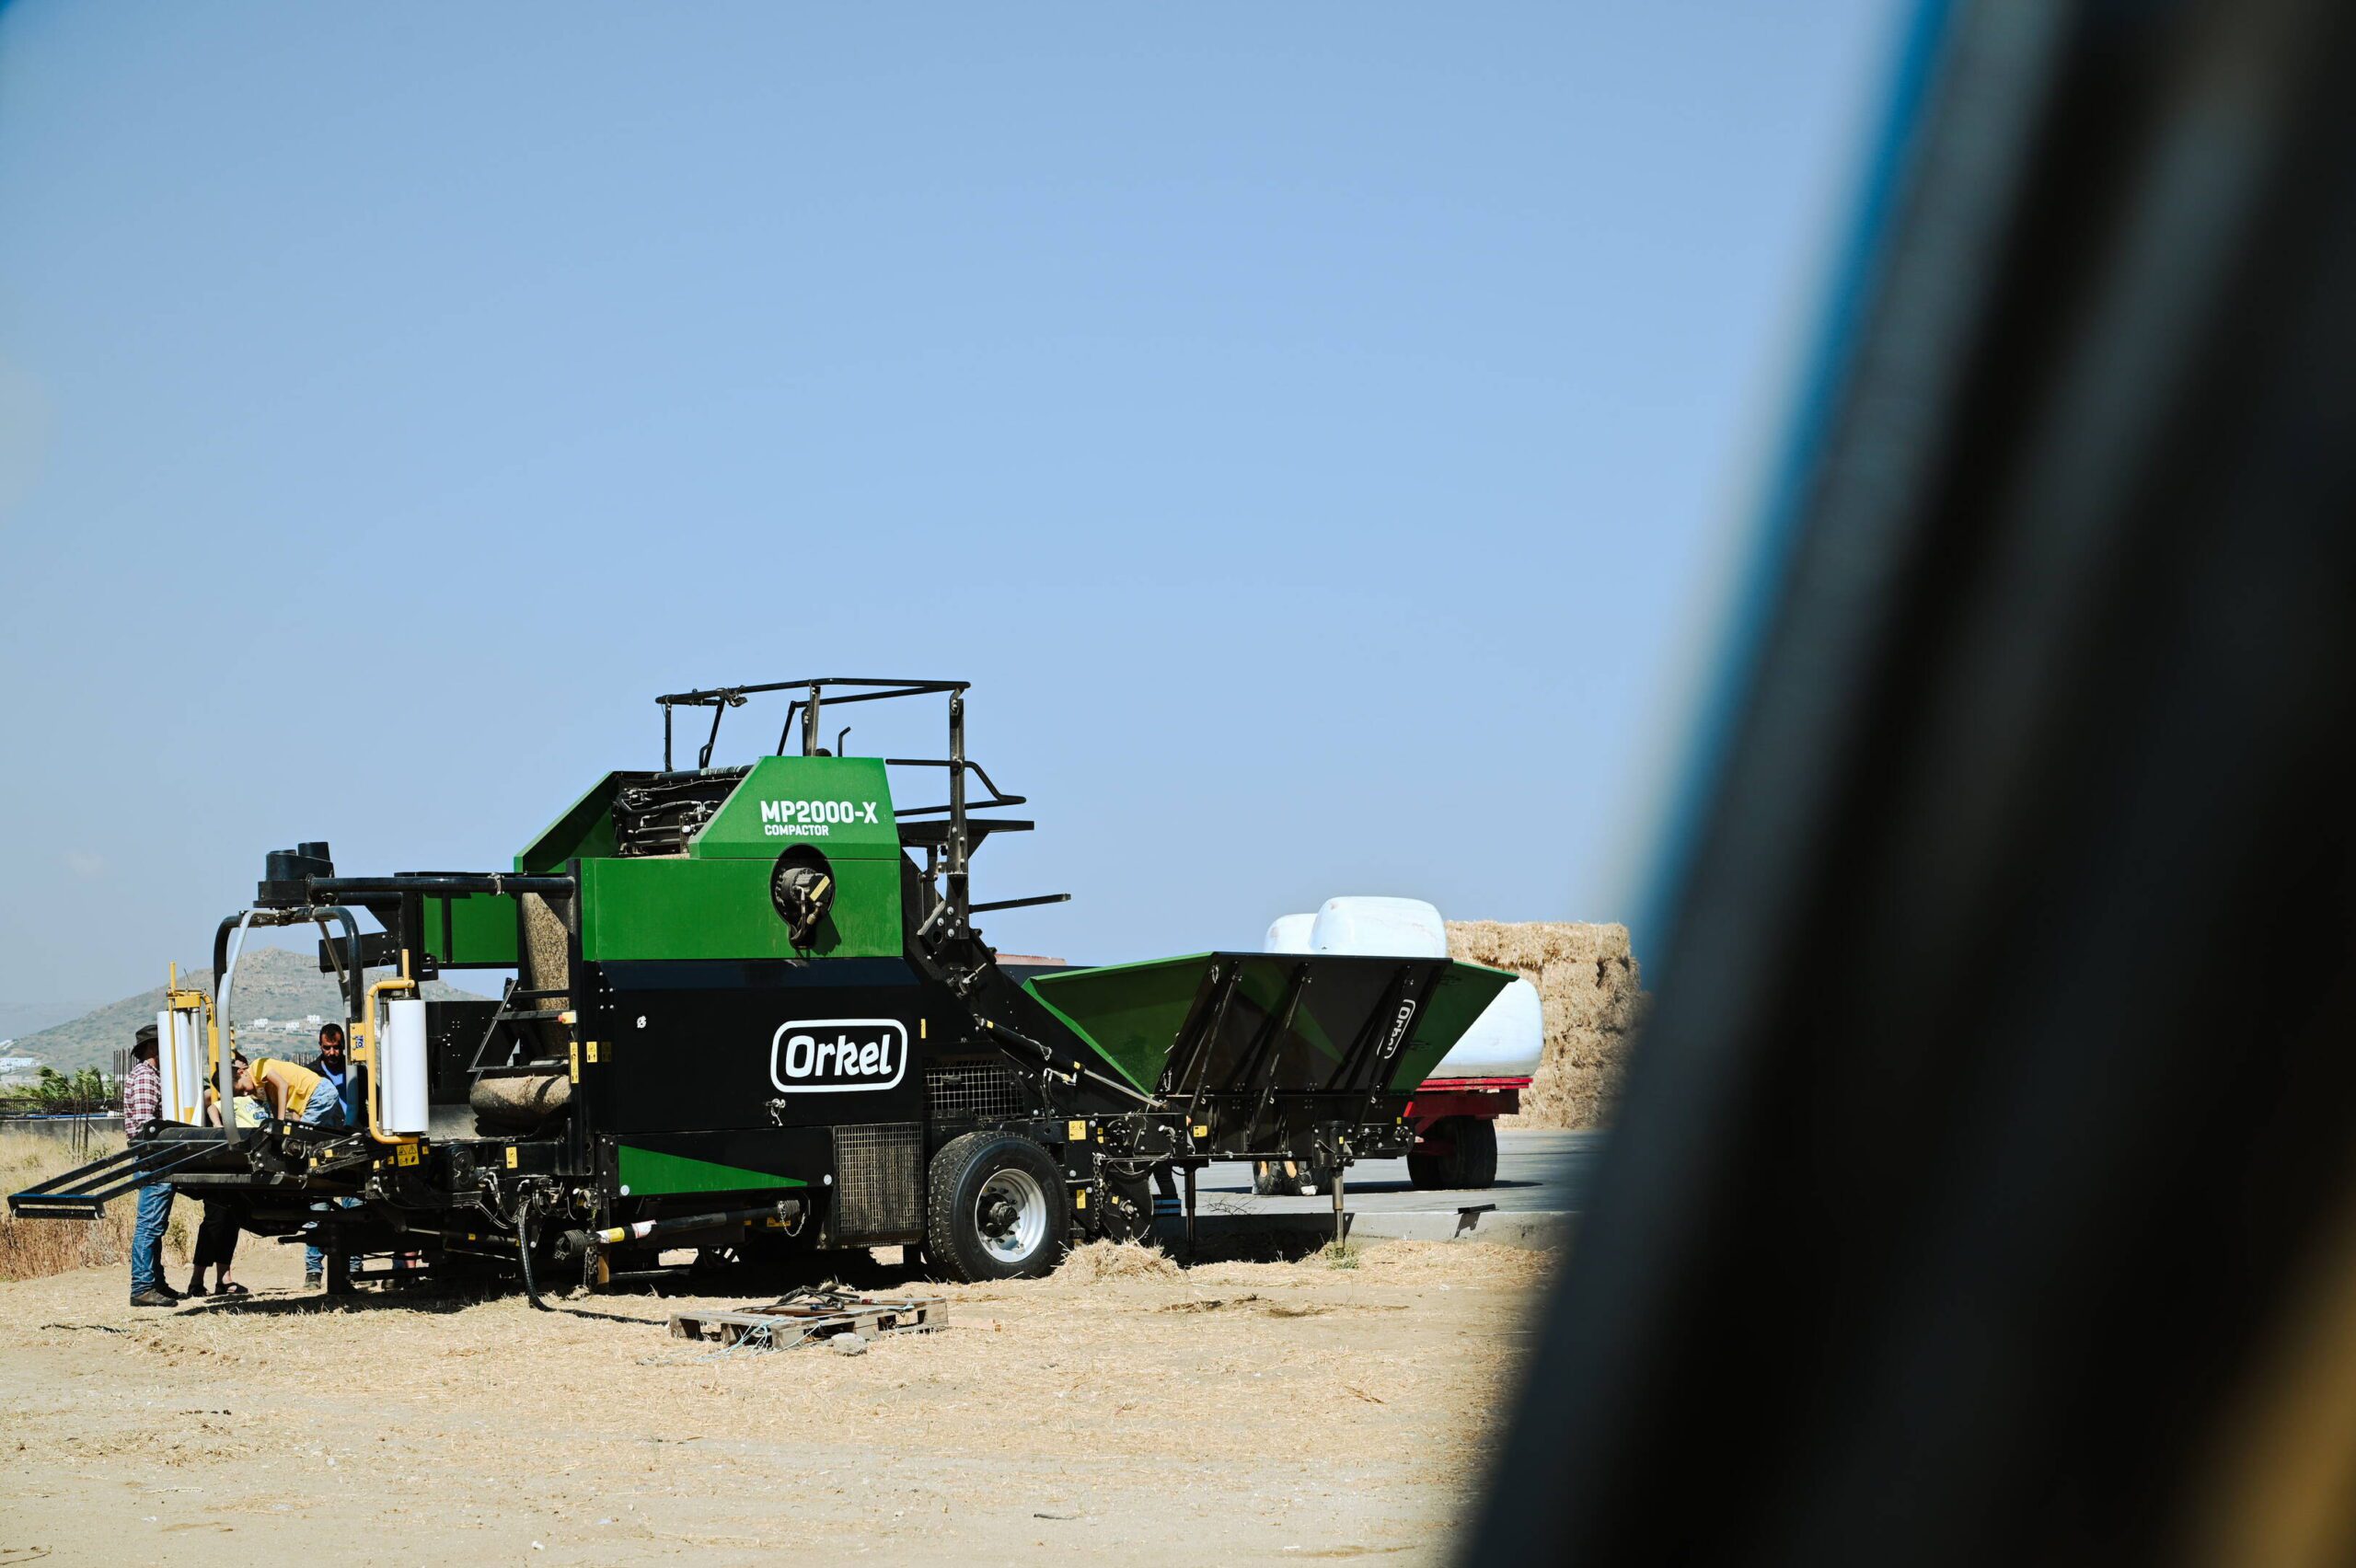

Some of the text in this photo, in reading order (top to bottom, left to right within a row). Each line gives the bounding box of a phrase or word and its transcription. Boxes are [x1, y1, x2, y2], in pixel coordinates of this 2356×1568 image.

[760, 800, 879, 824] MP2000-X
[765, 824, 829, 836] COMPACTOR
[785, 1033, 893, 1078] Orkel
